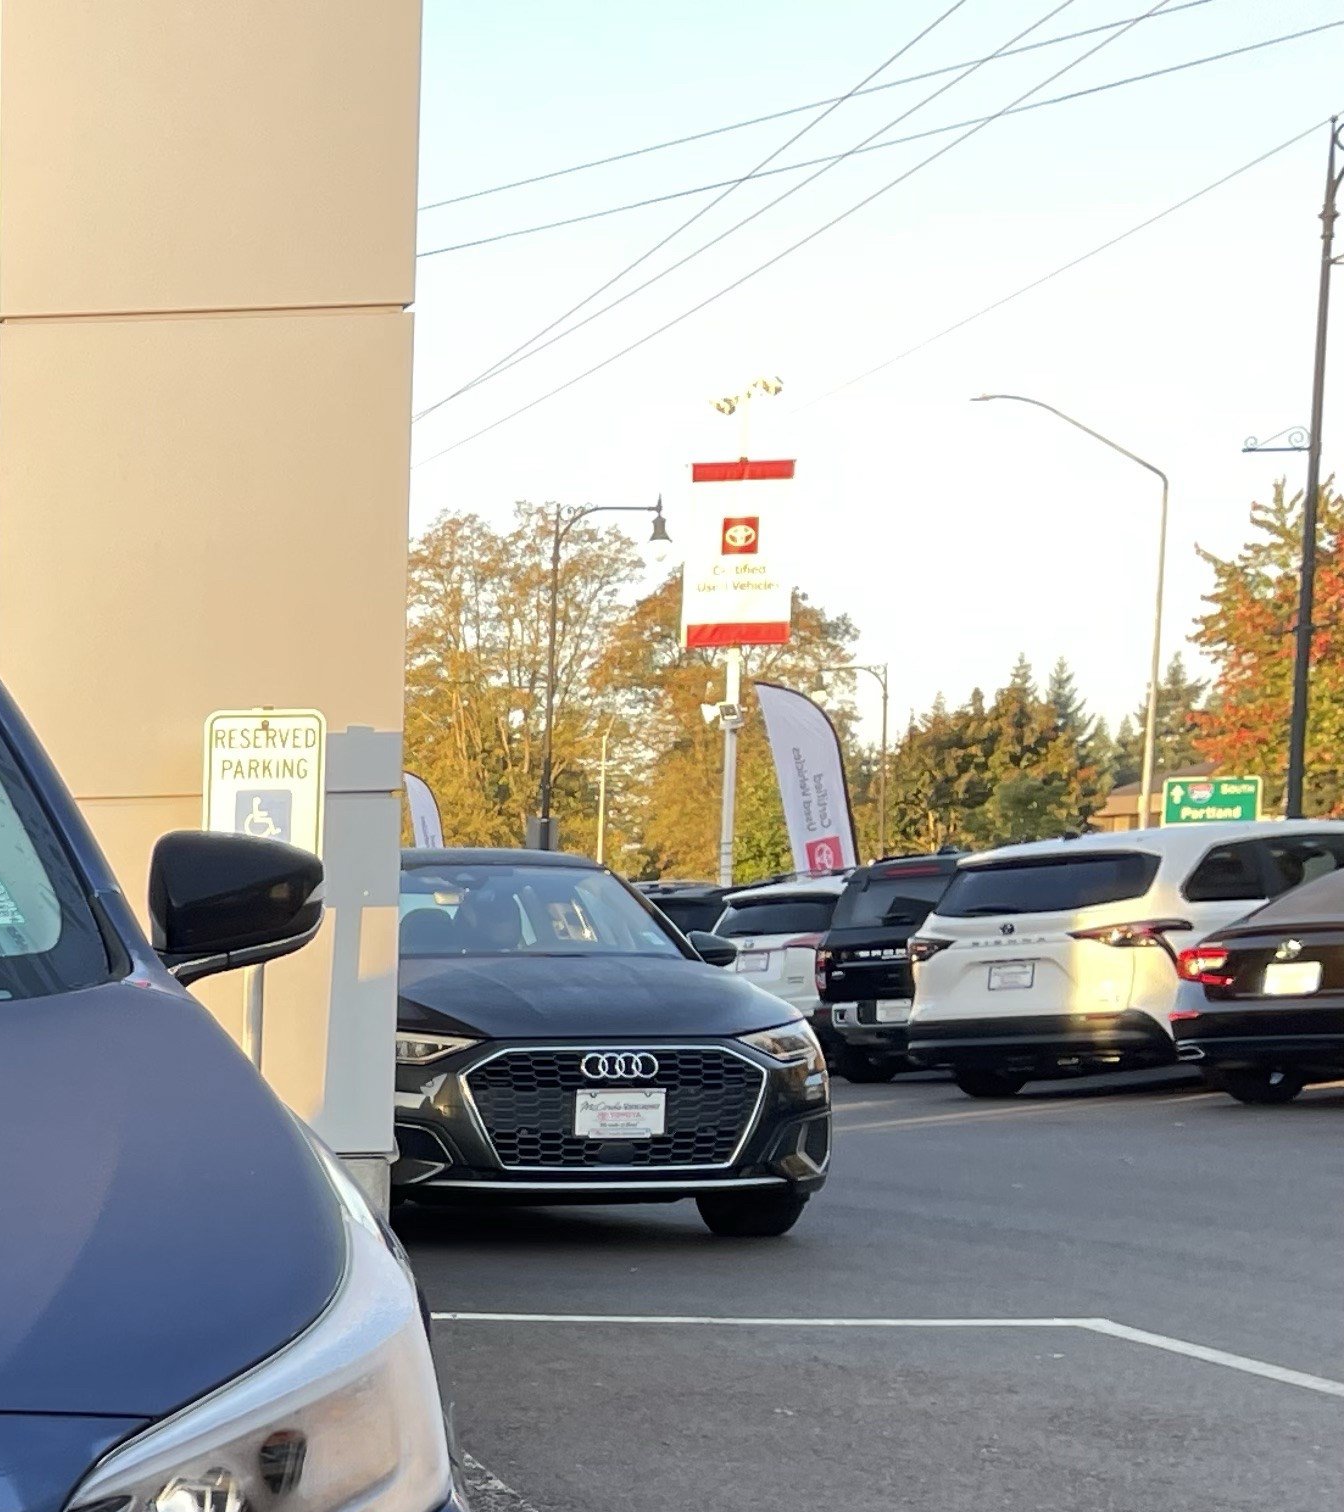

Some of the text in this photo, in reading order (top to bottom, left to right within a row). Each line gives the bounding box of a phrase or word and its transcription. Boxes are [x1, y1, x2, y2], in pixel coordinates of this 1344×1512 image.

[712, 563, 767, 575] Ctified
[697, 581, 728, 592] Usd
[214, 727, 316, 749] RESERVED
[220, 758, 309, 780] PARKING
[1180, 805, 1242, 820] Portland
